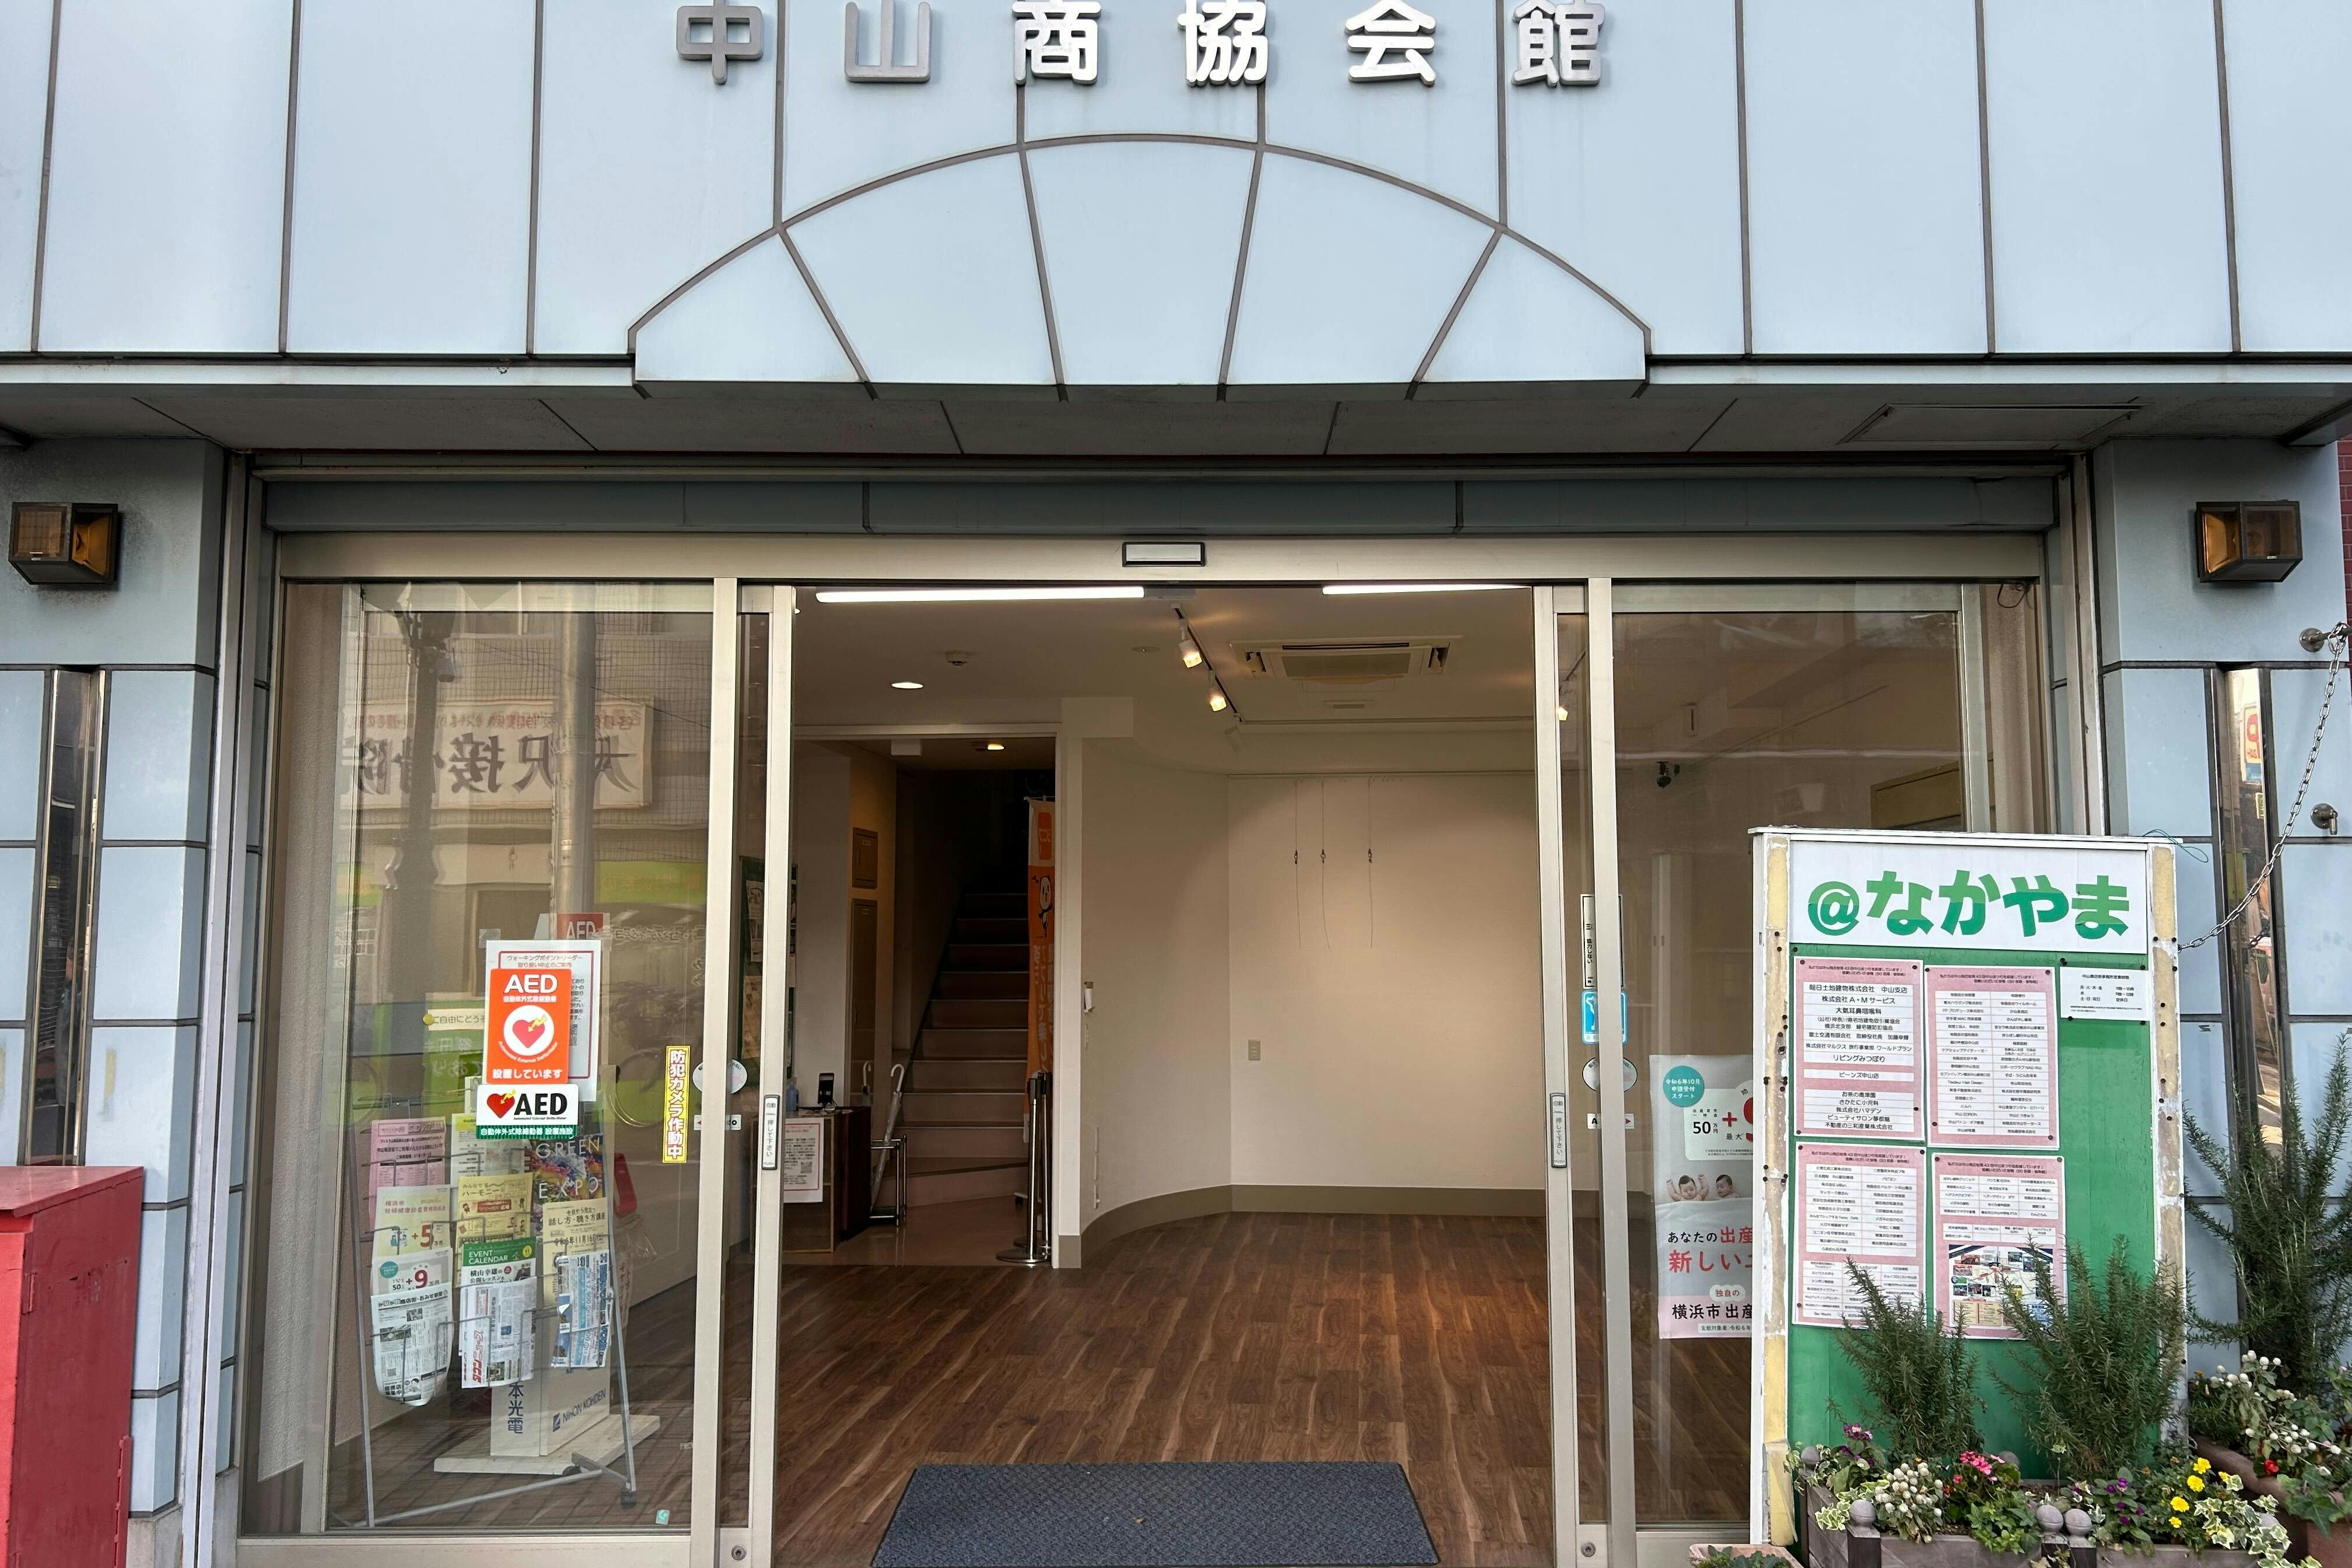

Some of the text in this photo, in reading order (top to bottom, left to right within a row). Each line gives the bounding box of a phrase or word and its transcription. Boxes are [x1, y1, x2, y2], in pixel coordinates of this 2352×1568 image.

[676, 0, 1606, 86] 中山商協会館
[1808, 870, 2130, 940] @なかやま
[503, 974, 559, 994] AED
[1809, 984, 1875, 993] 朝日土地建物株式会社
[493, 1069, 563, 1079] 設置しています
[514, 1093, 568, 1116] AED
[667, 1049, 687, 1160] 防犯カメラ作動中
[766, 1119, 775, 1157] 押して下さい
[1693, 1121, 1711, 1134] 50
[536, 1137, 600, 1158] GREEN
[538, 1176, 599, 1199] EXPO
[469, 1250, 494, 1258] EVENT
[469, 1255, 508, 1265] CALENDAR
[414, 1269, 428, 1289] 9
[1715, 1289, 1740, 1297] 独自の
[508, 1382, 524, 1434] 本光電
[562, 1402, 583, 1424] NIHON
